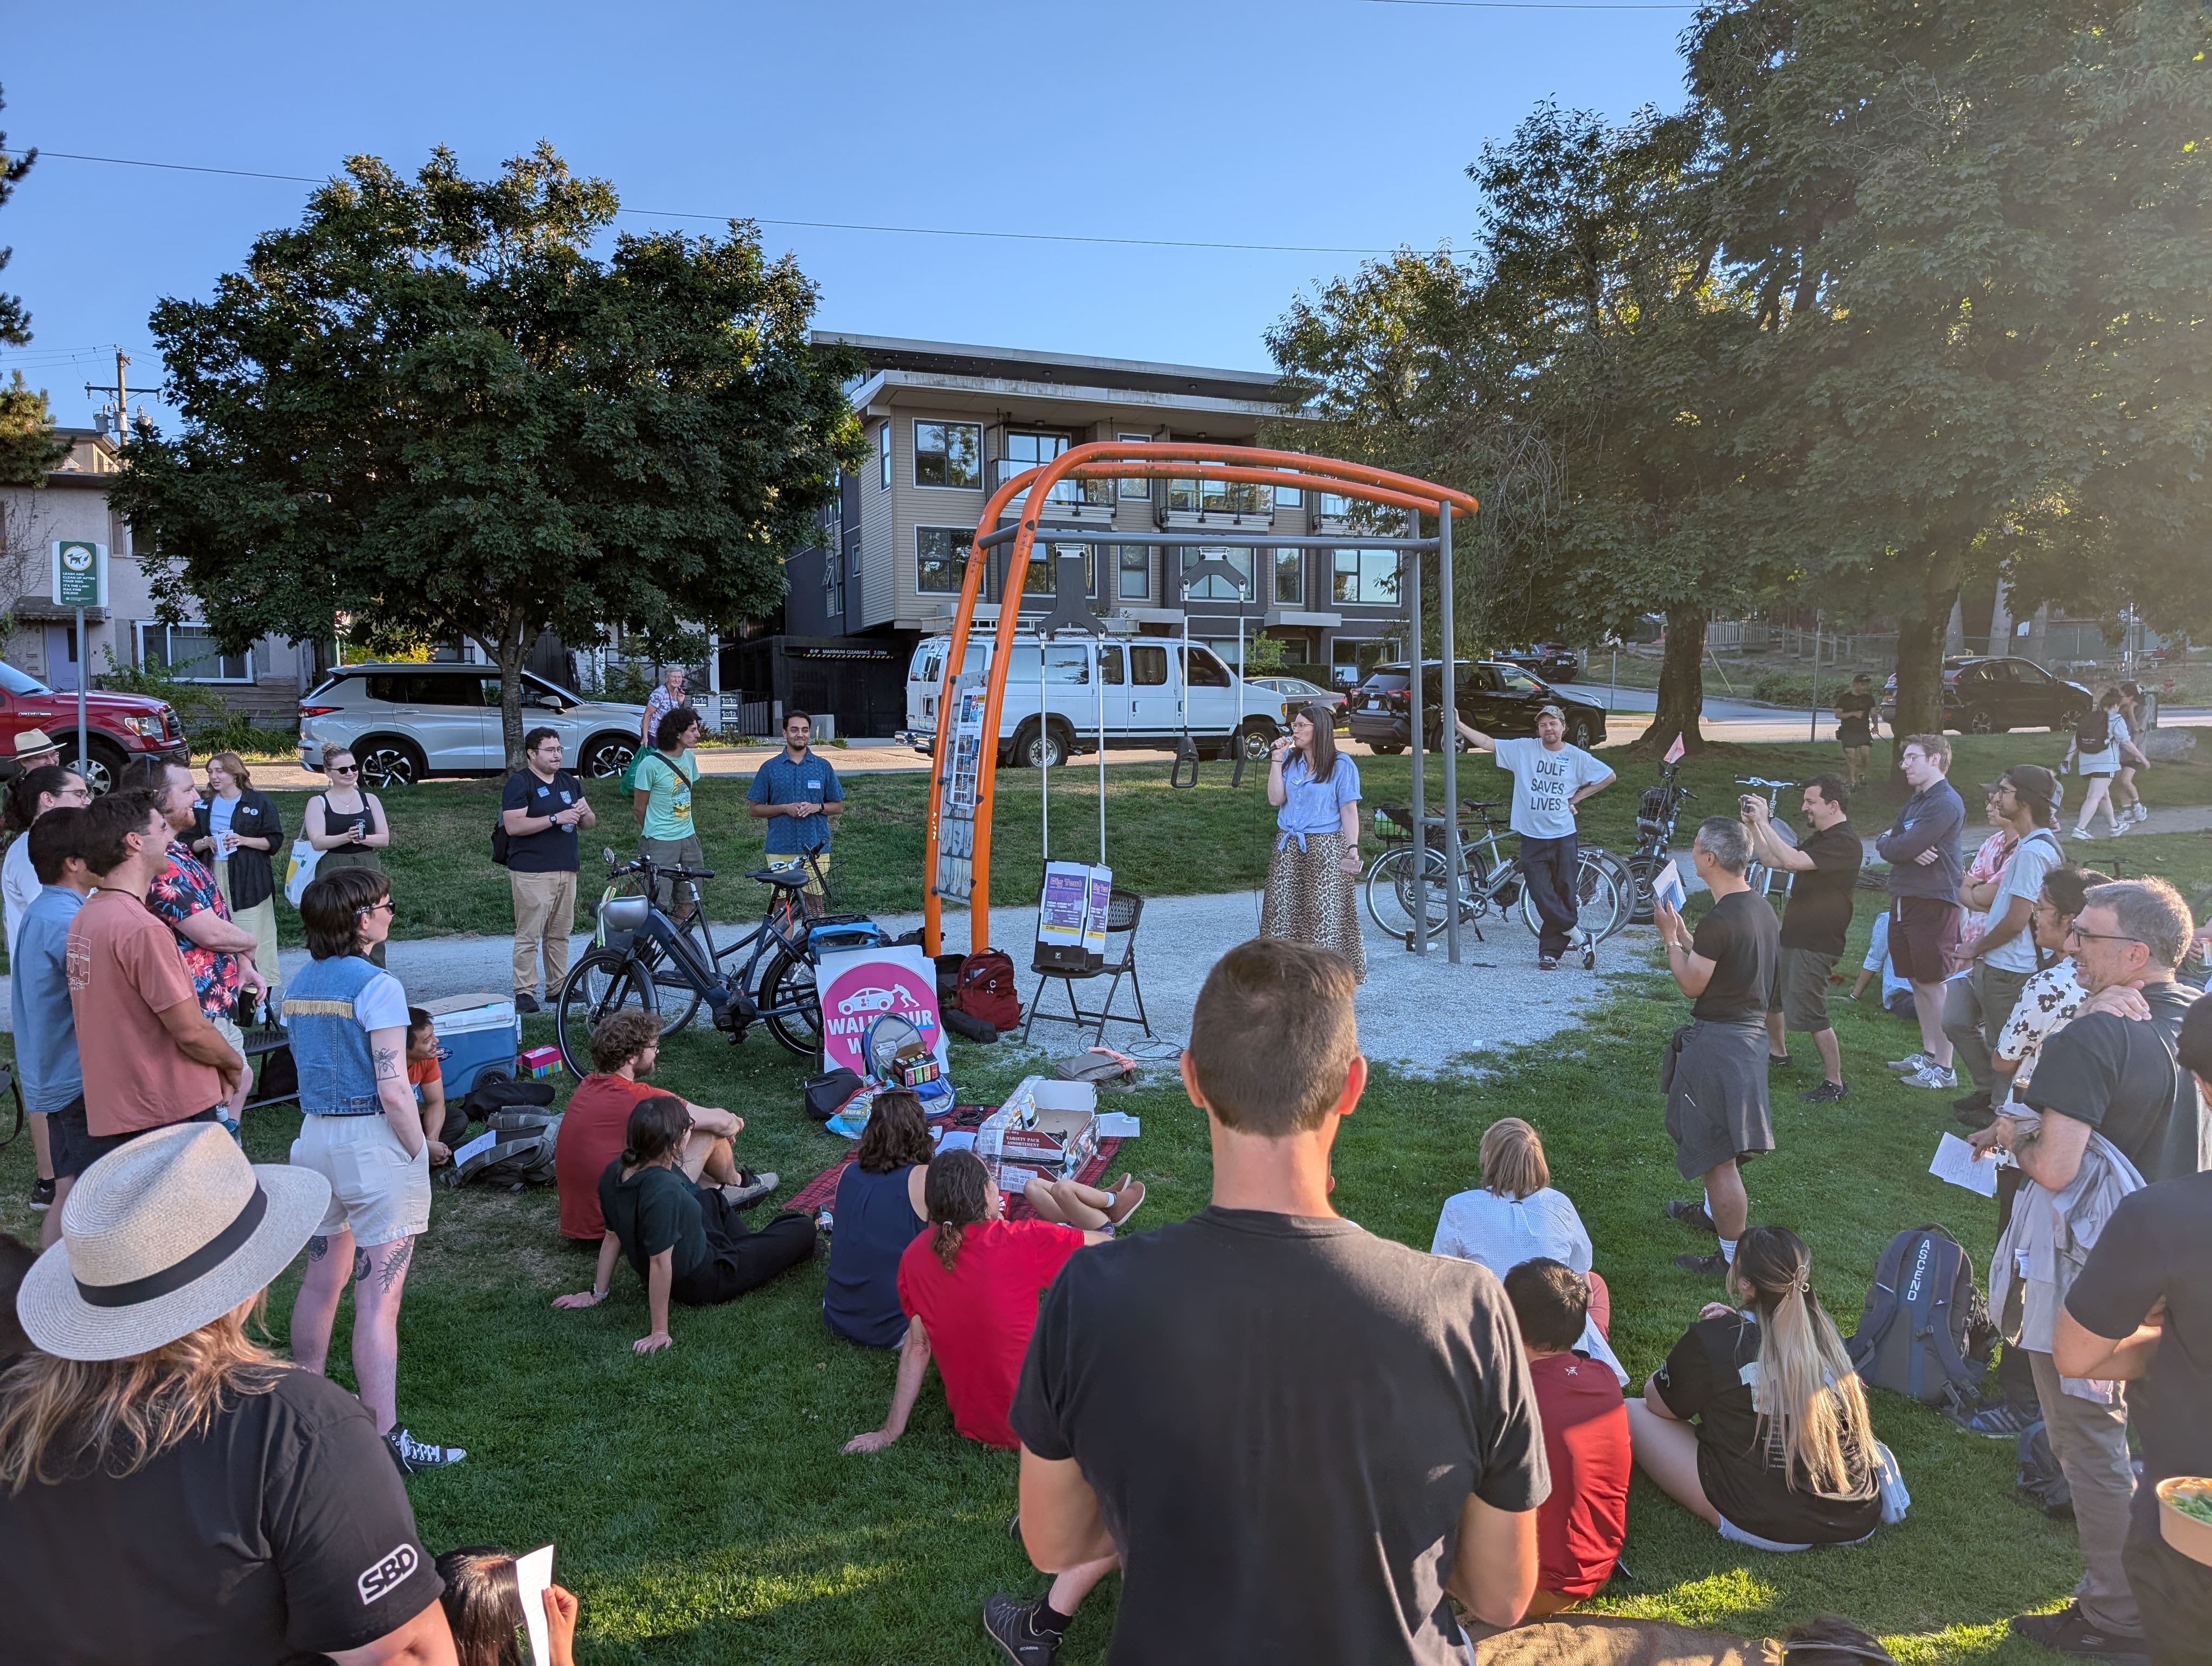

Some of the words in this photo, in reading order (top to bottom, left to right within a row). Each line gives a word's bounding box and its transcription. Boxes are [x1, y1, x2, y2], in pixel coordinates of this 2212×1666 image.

[1536, 760, 1565, 777] DULF
[1531, 778, 1565, 795] SAVES
[1531, 796, 1561, 811] LIVES
[1050, 876, 1064, 888] Big
[1064, 878, 1083, 888] Tent
[1907, 1239, 1930, 1301] ASCEND
[361, 1547, 416, 1601] SBD
